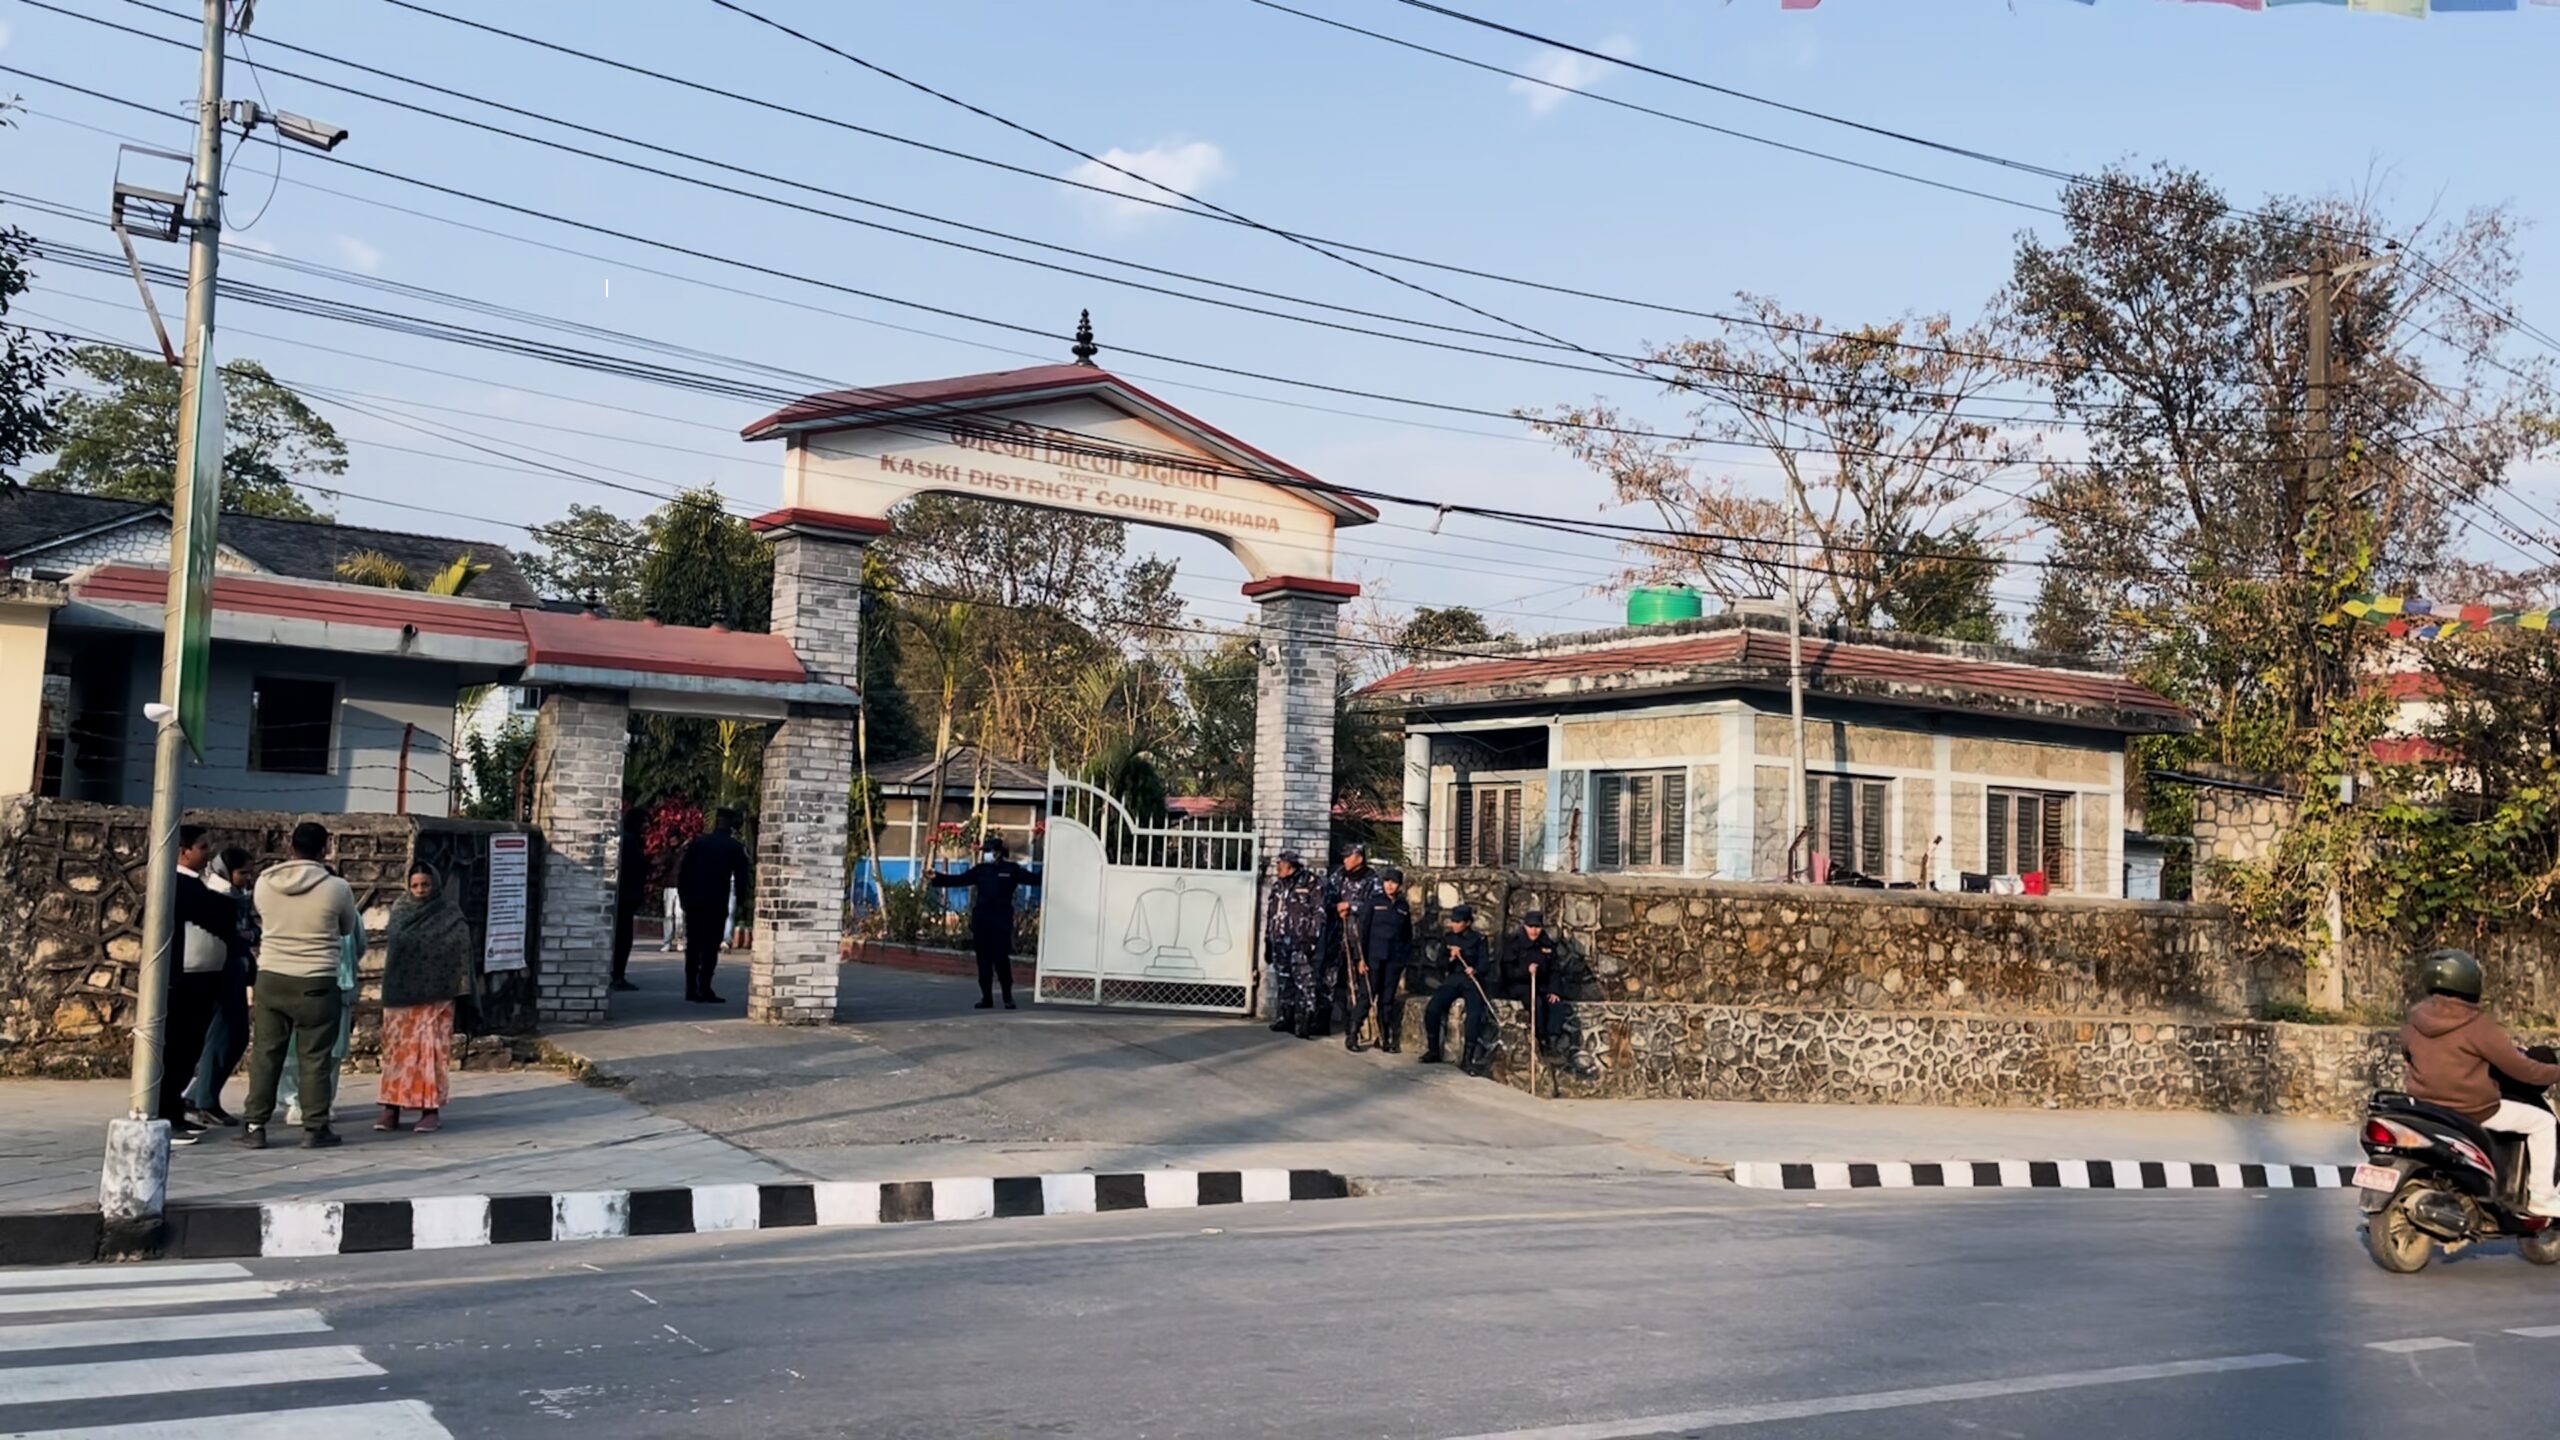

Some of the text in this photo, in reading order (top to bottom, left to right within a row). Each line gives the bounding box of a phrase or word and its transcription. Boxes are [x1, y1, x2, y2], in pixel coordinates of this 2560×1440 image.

[880, 454, 960, 483] KASKI
[969, 469, 1088, 502] DISTRICT
[1184, 503, 1280, 533] POKHARA
